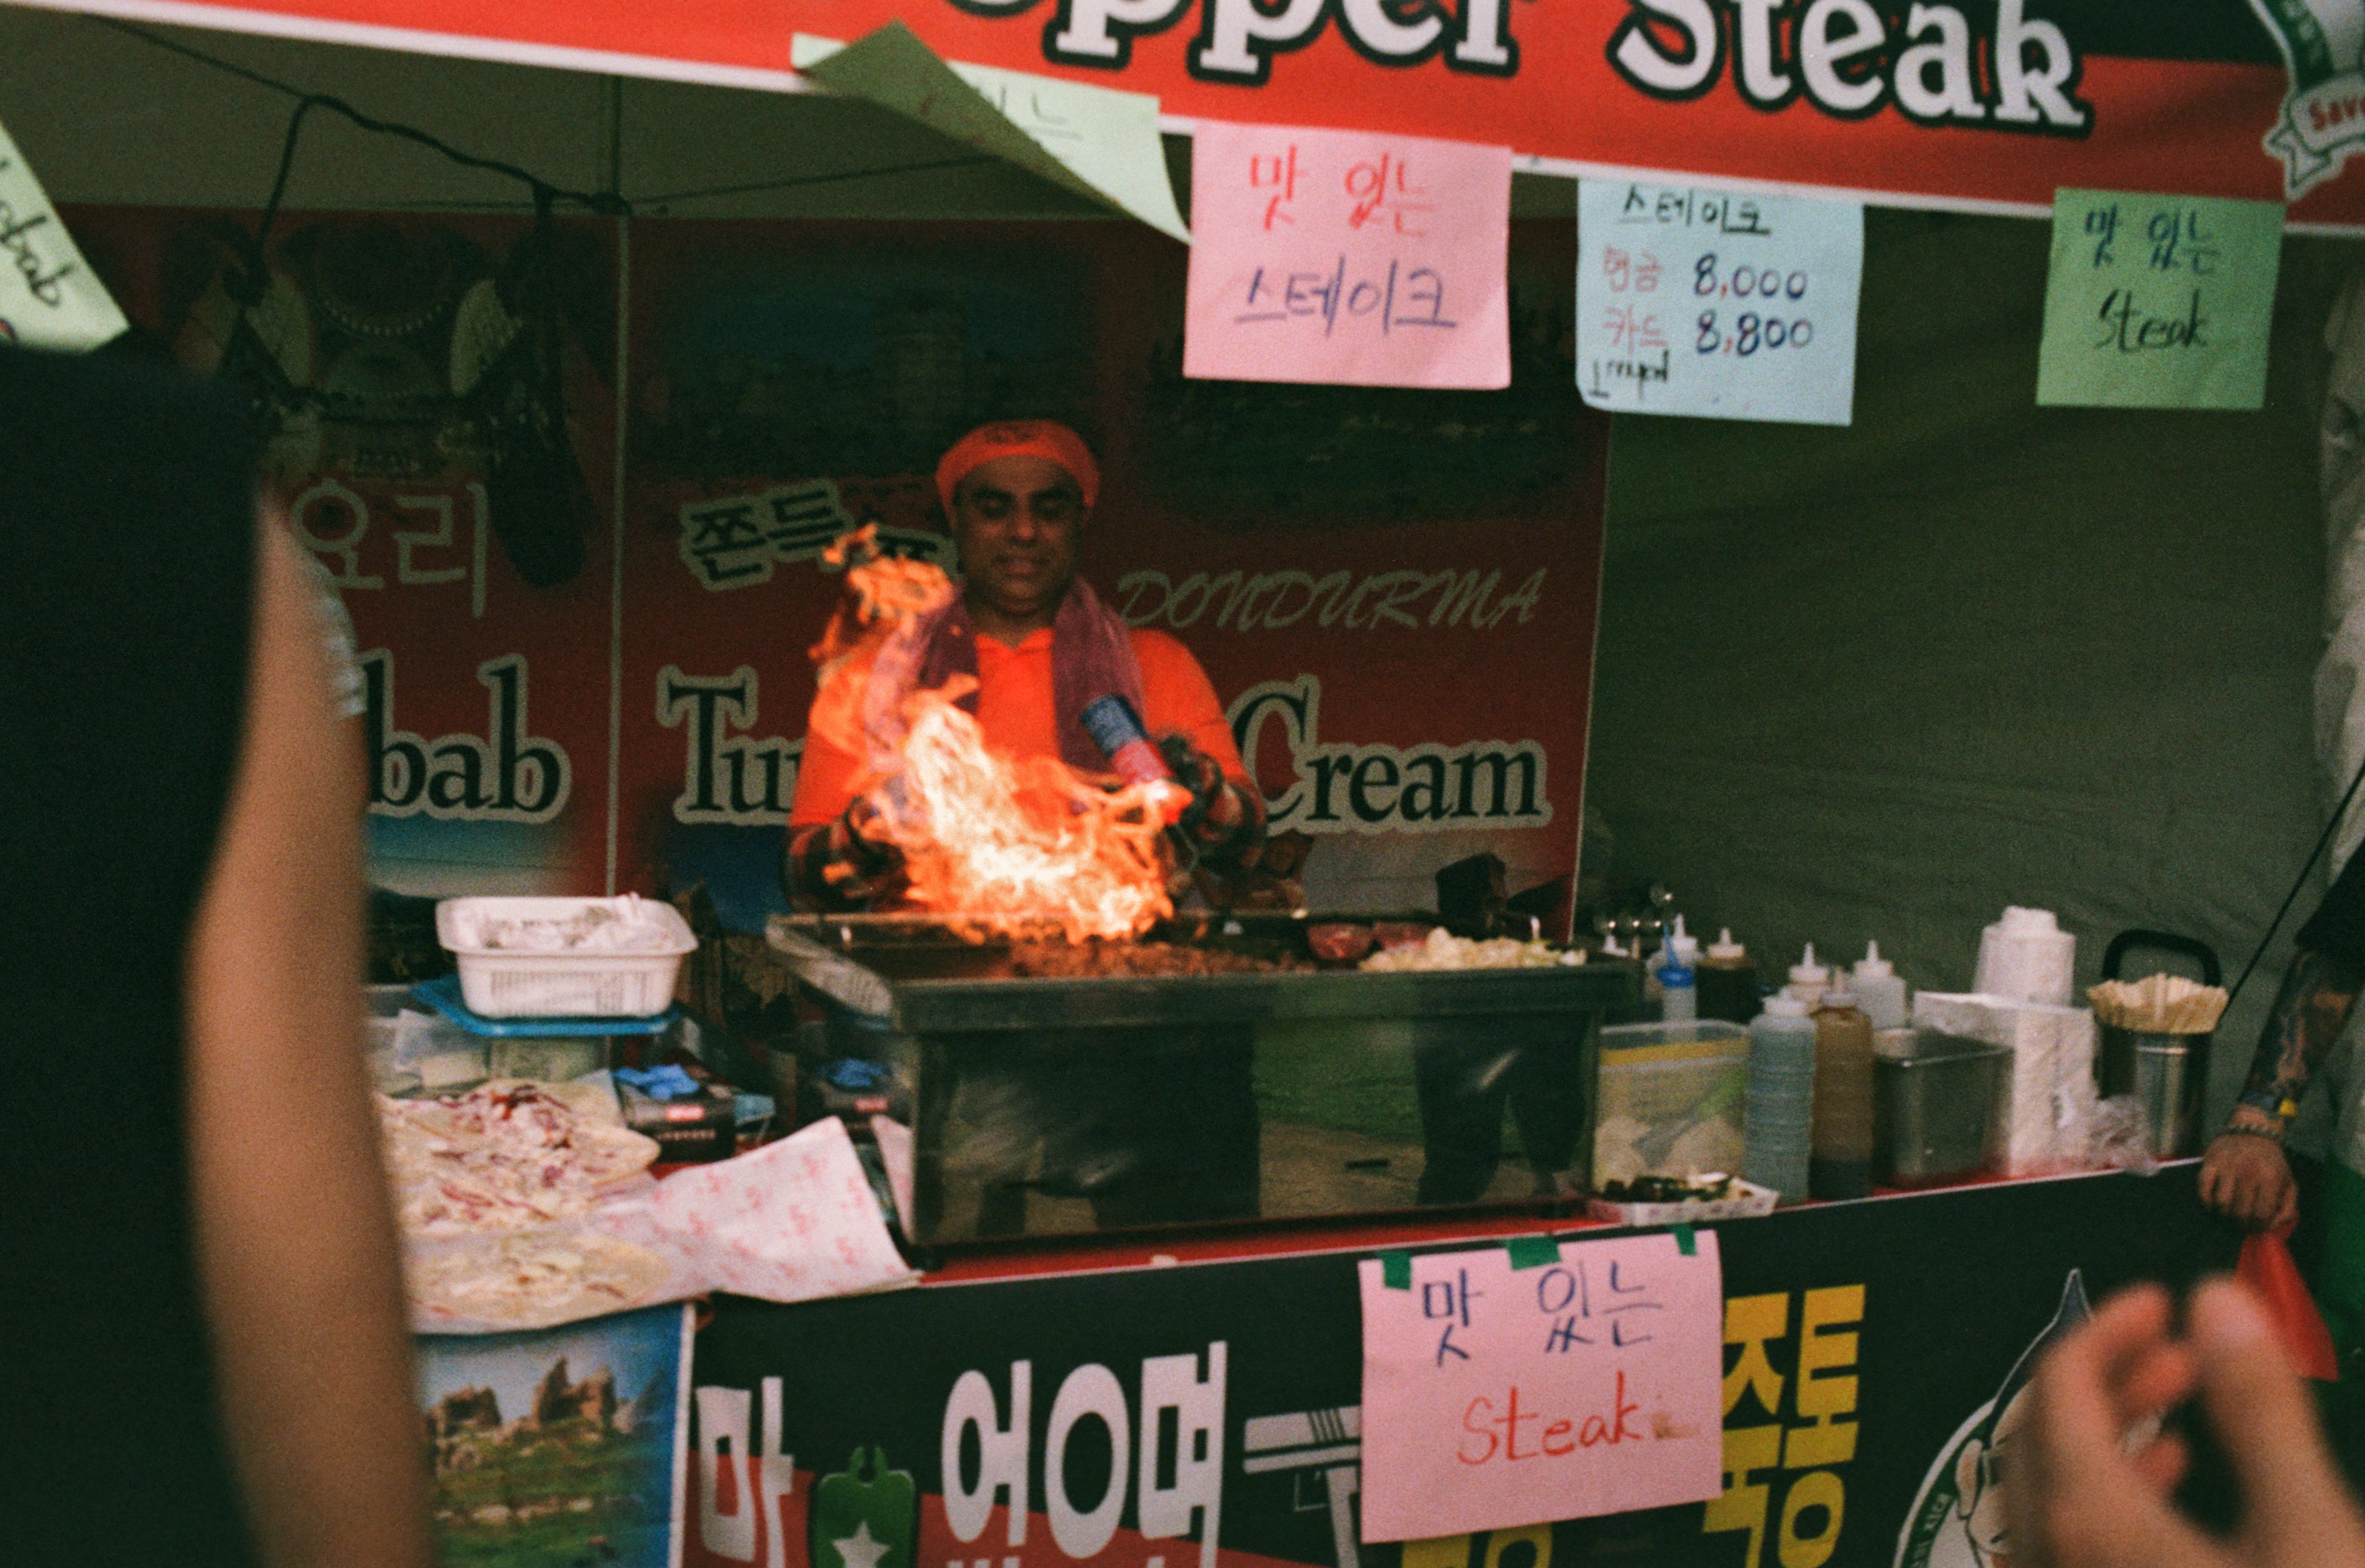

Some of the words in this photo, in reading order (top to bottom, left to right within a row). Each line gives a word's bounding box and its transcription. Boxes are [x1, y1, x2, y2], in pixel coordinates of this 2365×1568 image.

[1615, 0, 2085, 125] Steak
[1250, 144, 1309, 232] 맛
[1344, 153, 1435, 237] 있는
[1618, 185, 1772, 237] 스테이크
[1234, 254, 1458, 339] 스테이크
[1603, 244, 1664, 293] 현금
[1693, 252, 1807, 300] 8,000
[1602, 304, 1668, 356] 카드
[1695, 308, 1813, 357] 8,800
[291, 478, 488, 619] 요리
[1117, 568, 1547, 633] DONDURMA
[363, 659, 561, 814] bab
[1224, 685, 1543, 824] Cream
[1422, 1269, 1484, 1369] 맛
[1537, 1260, 1664, 1354] 있는
[1457, 1370, 1641, 1465] Steak
